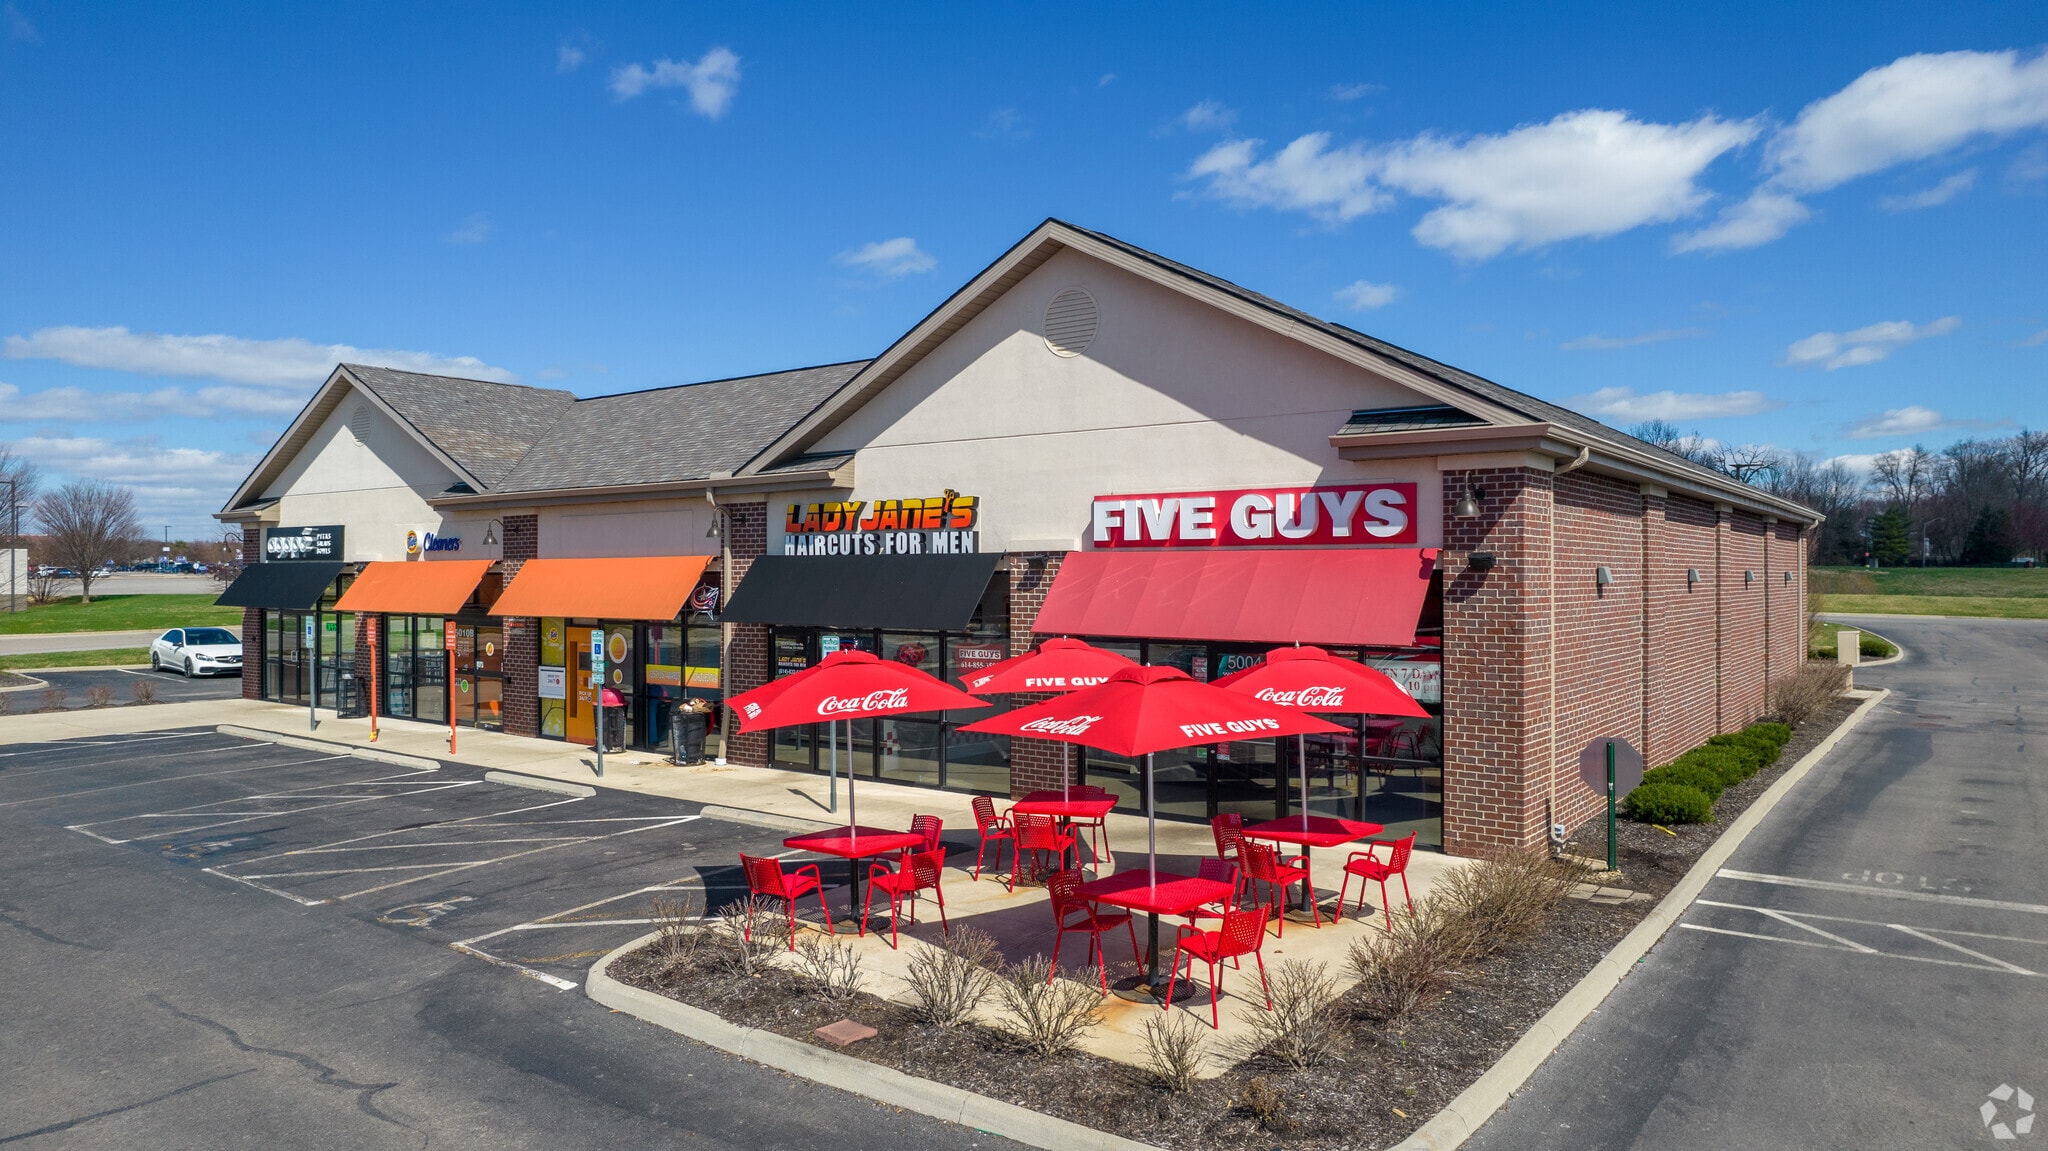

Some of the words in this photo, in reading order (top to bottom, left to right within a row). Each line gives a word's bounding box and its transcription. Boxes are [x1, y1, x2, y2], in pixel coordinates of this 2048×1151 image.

[785, 501, 861, 533] LADY
[860, 489, 975, 531] JANE'S
[1094, 496, 1216, 541] FIVE
[1230, 489, 1409, 540] GUYS
[423, 532, 461, 551] Cleaners
[784, 533, 876, 556] HAIRCUTS
[885, 533, 921, 554] FOR
[932, 531, 974, 554] MEN
[960, 650, 976, 658] FIVE
[1227, 655, 1261, 670] 5004
[1026, 678, 1066, 687] FIVE
[1071, 677, 1109, 686] GUY
[1401, 668, 1408, 679] 7
[1408, 681, 1420, 691] 10
[817, 687, 909, 715] Coca-Cola
[1020, 715, 1104, 737] Coca-Cola
[1179, 722, 1228, 738] FIVE
[1226, 718, 1280, 733] GUYS
